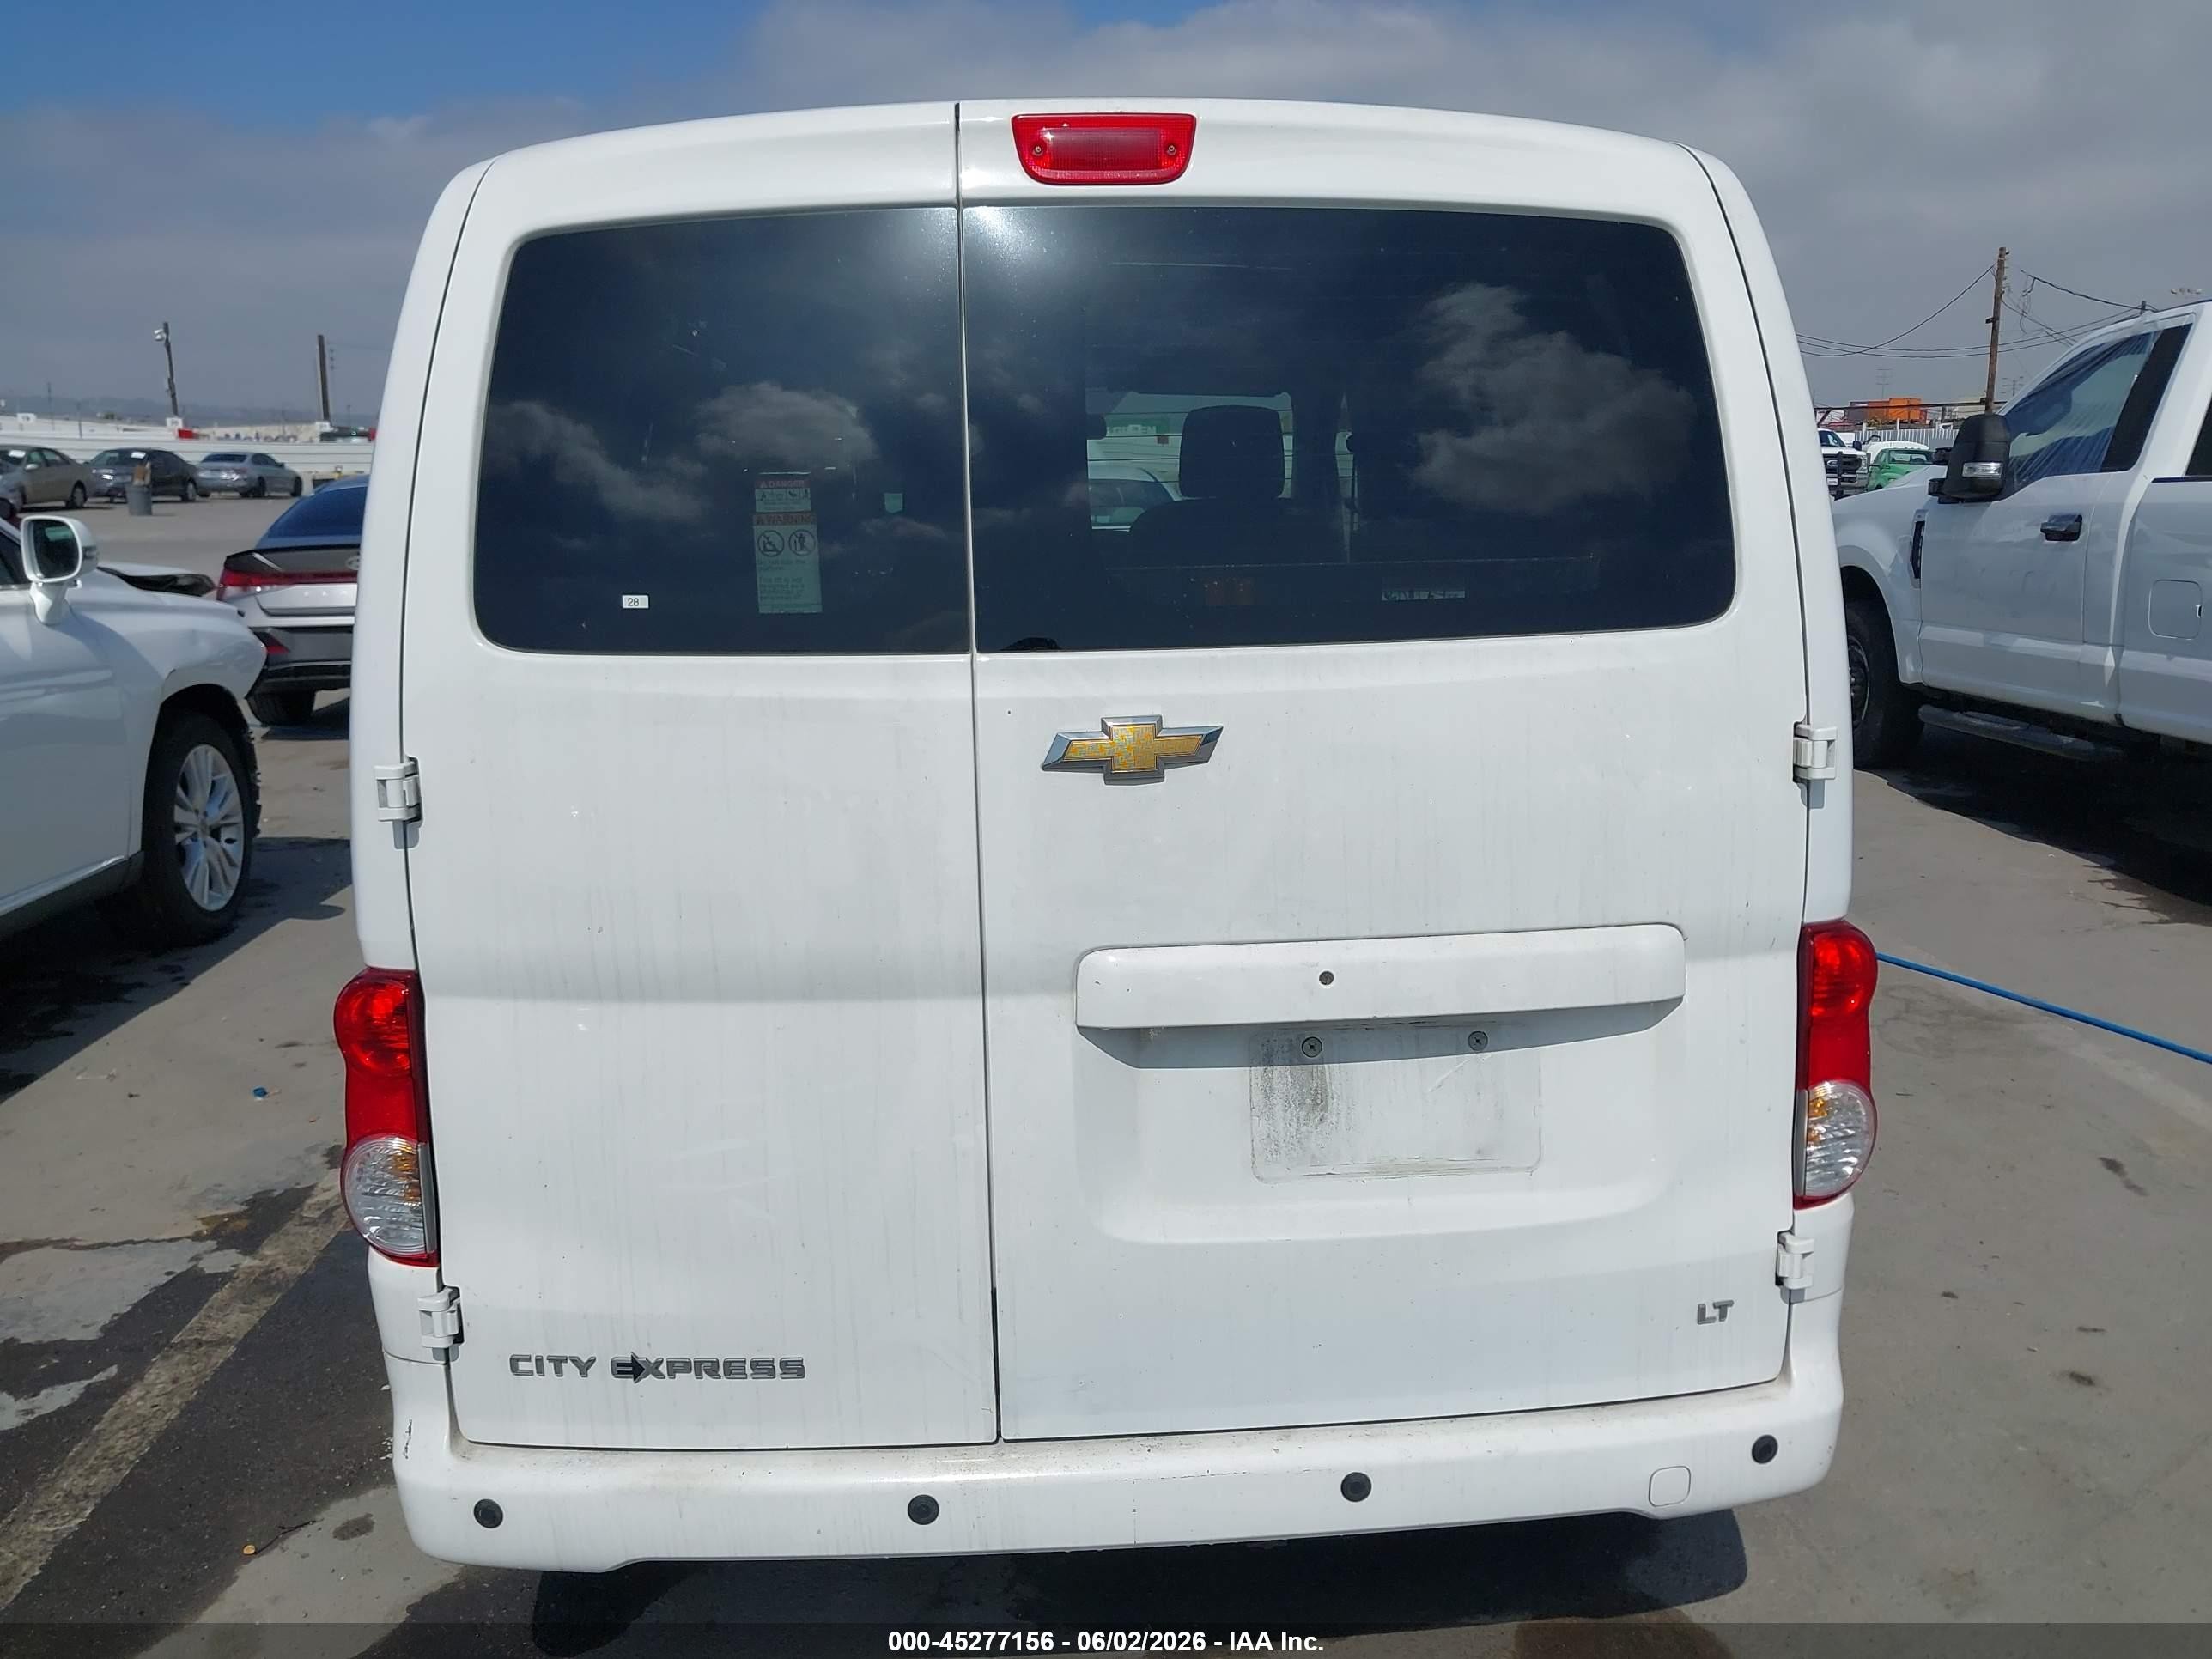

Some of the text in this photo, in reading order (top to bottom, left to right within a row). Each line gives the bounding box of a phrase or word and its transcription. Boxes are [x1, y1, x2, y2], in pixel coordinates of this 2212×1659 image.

[628, 597, 640, 607] 28
[1697, 1299, 1735, 1325] LT
[509, 1354, 806, 1381] CITY EXPRESS
